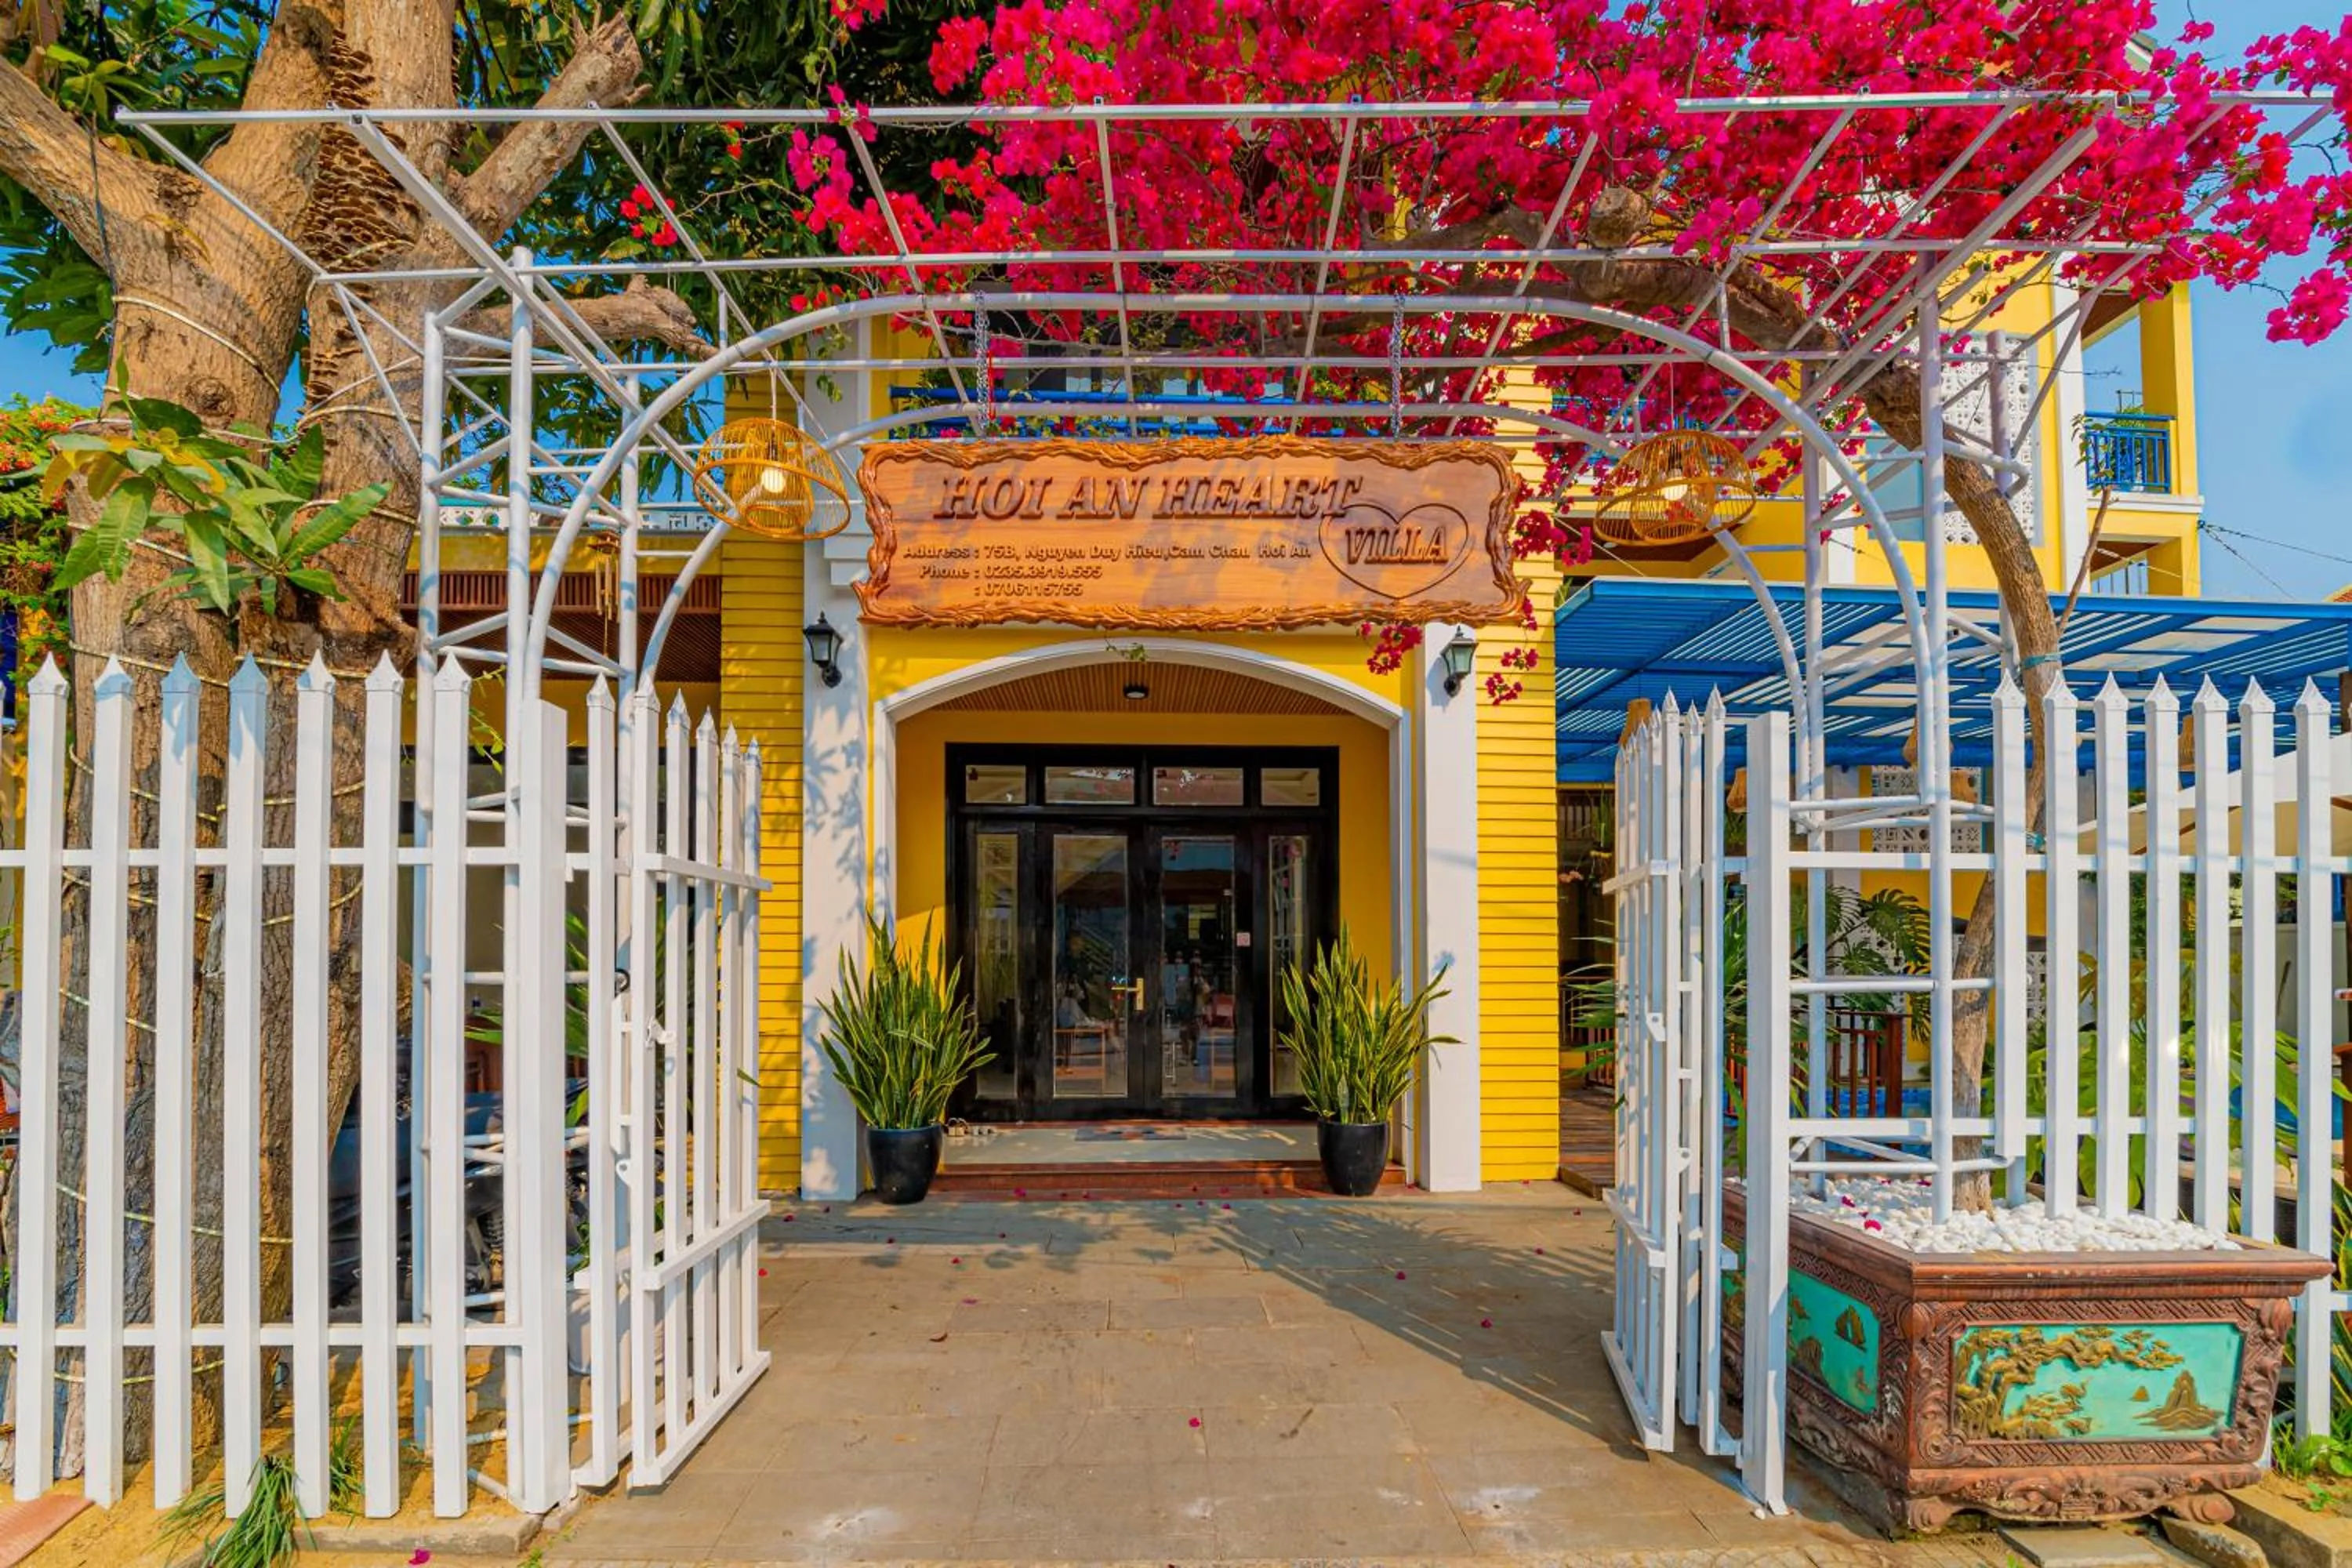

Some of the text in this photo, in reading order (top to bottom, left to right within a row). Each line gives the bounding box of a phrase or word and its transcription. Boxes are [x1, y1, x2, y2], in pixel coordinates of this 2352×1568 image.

[934, 475, 1363, 519] HOI AN HEART
[1025, 545, 1086, 561] Nguyen
[1090, 545, 1121, 561] Duy
[1258, 543, 1287, 559] Hoi
[1290, 544, 1312, 559] An
[1345, 525, 1449, 565] VILLA
